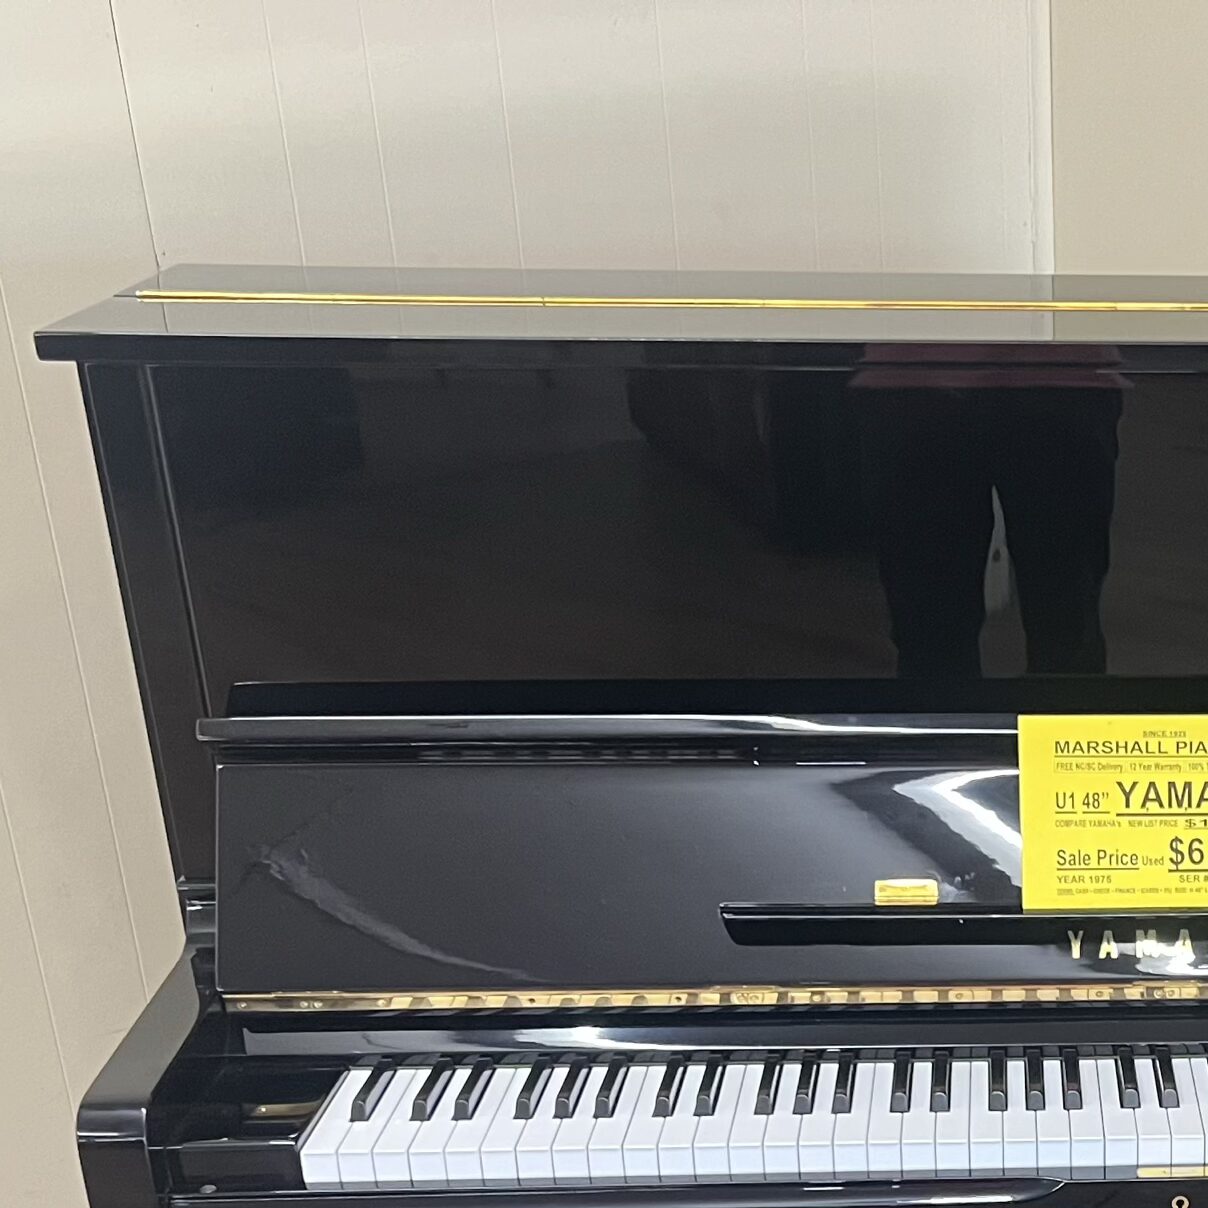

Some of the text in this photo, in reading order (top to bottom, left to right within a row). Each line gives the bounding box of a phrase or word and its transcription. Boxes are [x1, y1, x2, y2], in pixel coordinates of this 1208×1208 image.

[1054, 740, 1169, 755] MARSHALL
[1056, 762, 1074, 771] FREE
[1055, 792, 1076, 809] U1
[1159, 819, 1178, 828] PRICE
[1056, 849, 1092, 867] Sale
[1097, 849, 1139, 867] Price
[1141, 855, 1165, 866] Used
[1056, 875, 1112, 884] YEAR 1975
[1179, 874, 1201, 883] SER
